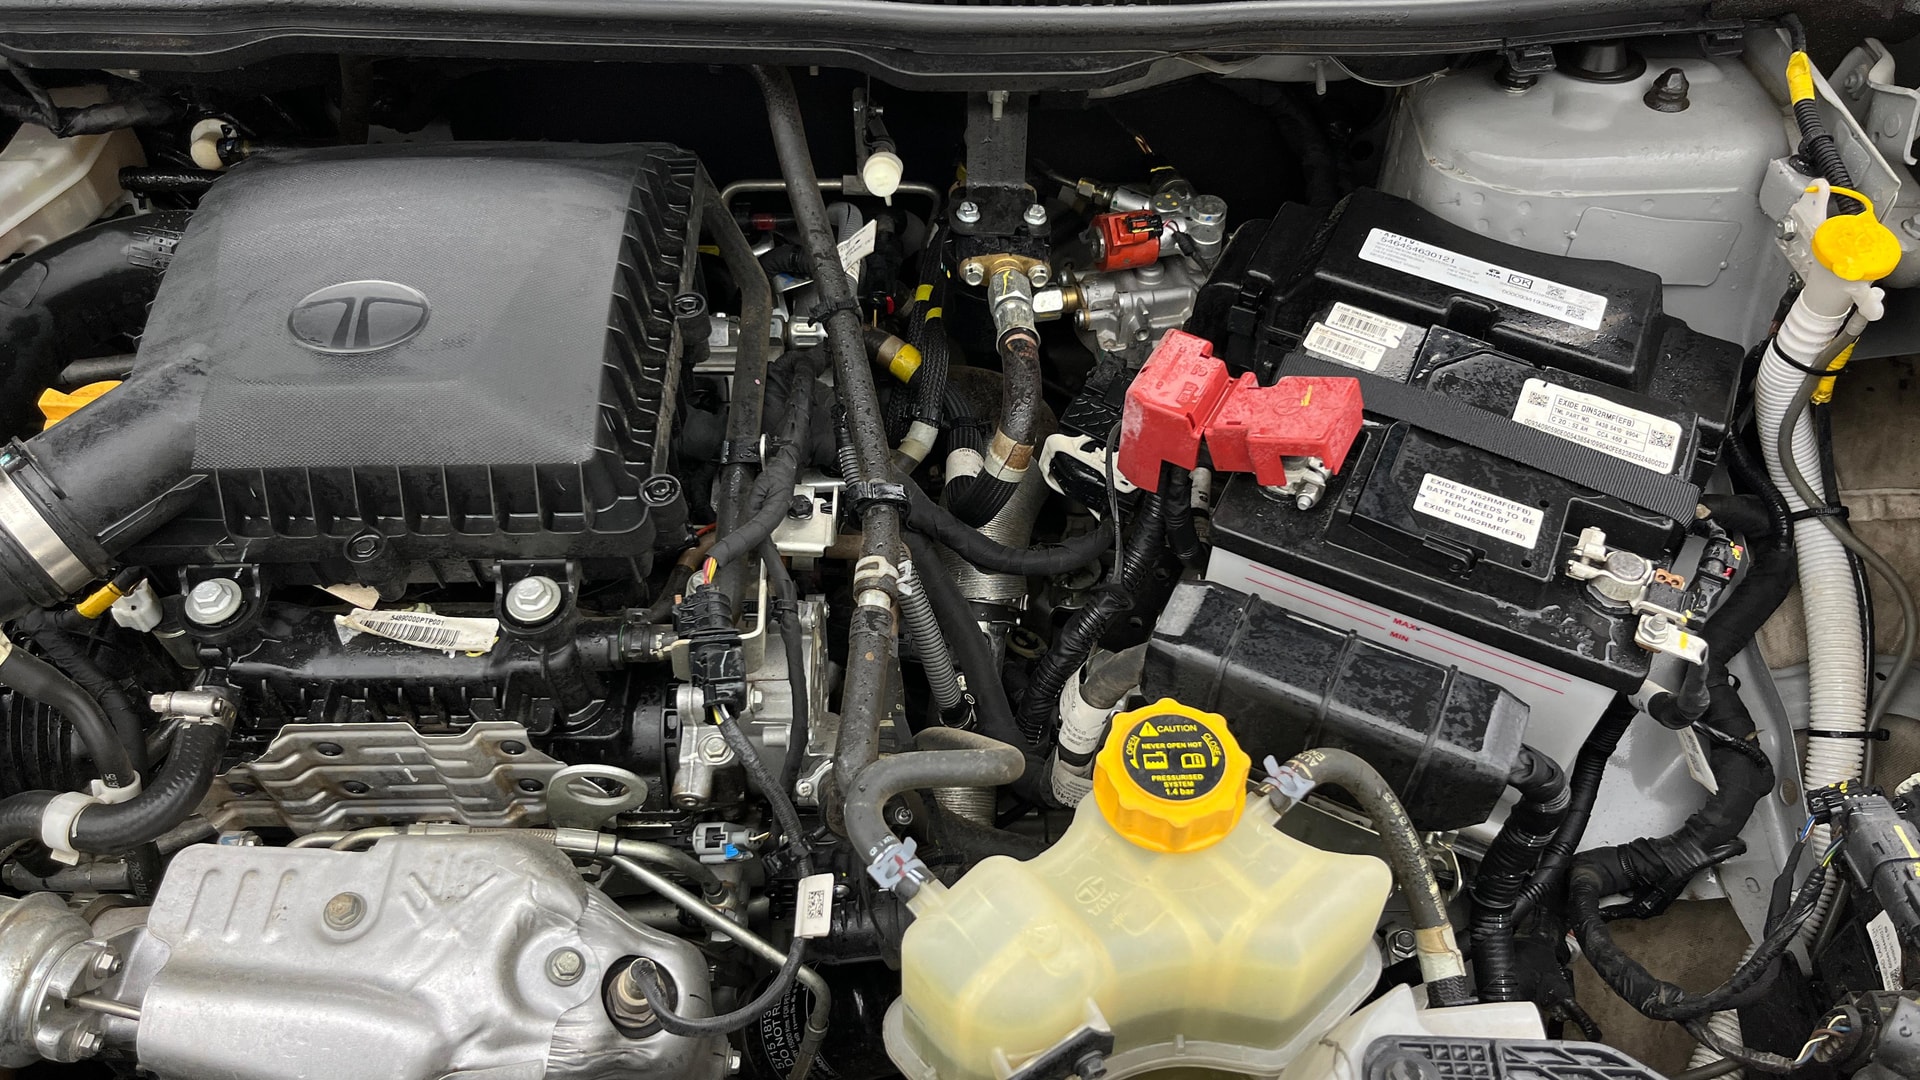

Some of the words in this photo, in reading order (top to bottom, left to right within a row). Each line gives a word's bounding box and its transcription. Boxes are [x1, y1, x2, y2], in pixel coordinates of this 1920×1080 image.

[1511, 276, 1530, 286] OK
[1558, 398, 1579, 410] EXIDE
[1581, 405, 1635, 428] DIN52RMF(EFB)
[1566, 411, 1580, 421] PART
[1597, 430, 1608, 439] CCA
[1426, 485, 1467, 502] BATTERY
[1470, 500, 1502, 515] NEEDS
[1507, 511, 1519, 520] TO
[1431, 478, 1457, 490] EXIDE
[1461, 488, 1531, 516] DIN52RMF(EFB)
[1424, 502, 1451, 515] EXIDE
[1454, 512, 1526, 541] DIN52RMF(EFB)
[1444, 499, 1493, 519] REPLACED
[1497, 516, 1510, 524] BY
[1393, 618, 1417, 630] MAX
[1390, 632, 1409, 642] MIN
[1156, 724, 1197, 733] CAUTION
[1126, 735, 1138, 755] OPEN
[1203, 733, 1222, 757] CLOSE
[763, 1010, 773, 1039] 1813
[773, 1020, 786, 1046] NOT
[767, 1042, 785, 1069] 5715
[780, 1049, 794, 1067] DO
